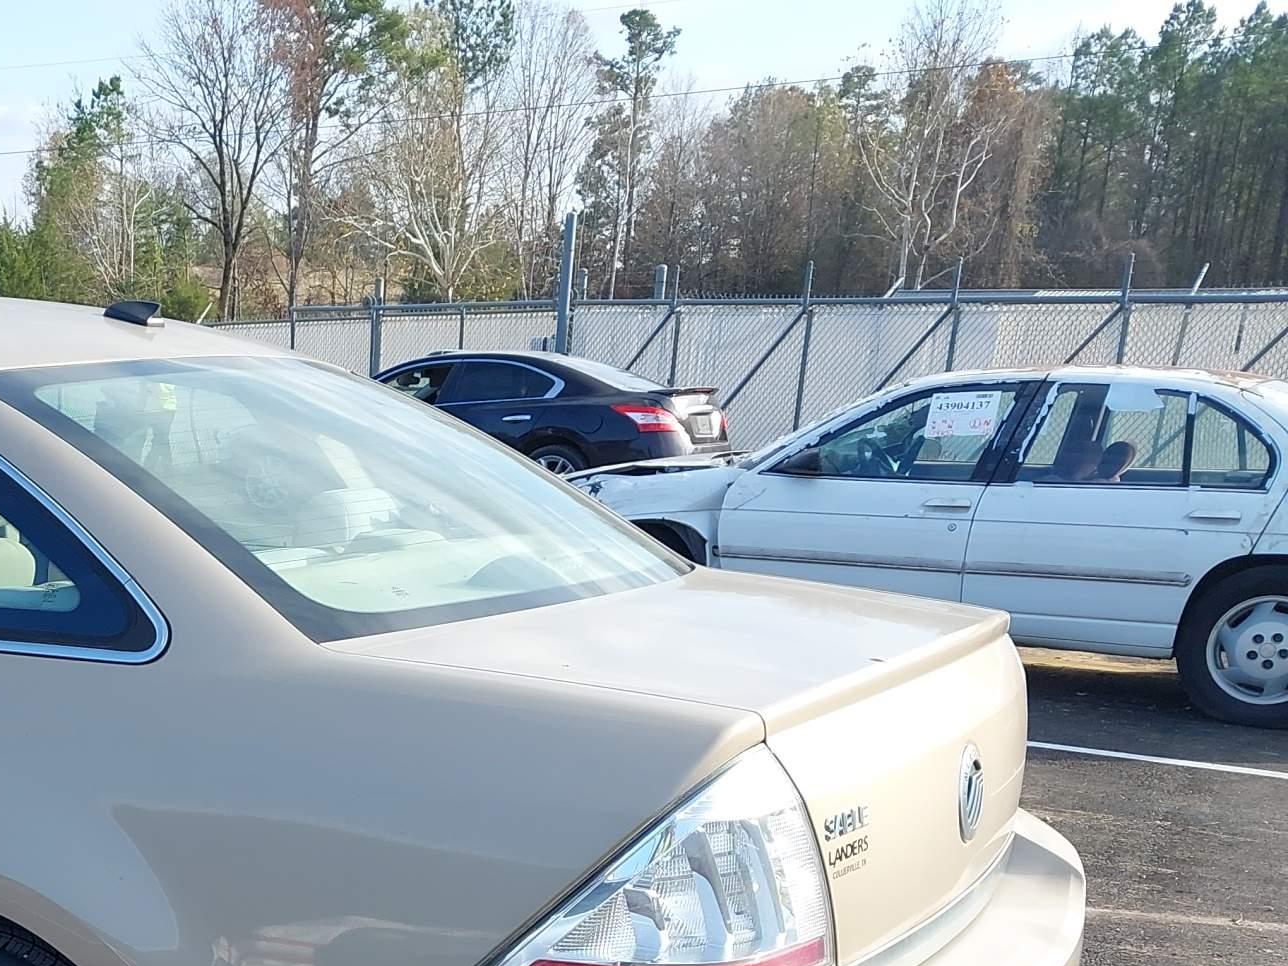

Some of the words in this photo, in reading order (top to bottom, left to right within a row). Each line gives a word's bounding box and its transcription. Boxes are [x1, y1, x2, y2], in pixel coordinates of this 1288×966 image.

[936, 400, 991, 410] 43904137
[823, 804, 870, 842] SABLE
[828, 835, 869, 868] LANDERS
